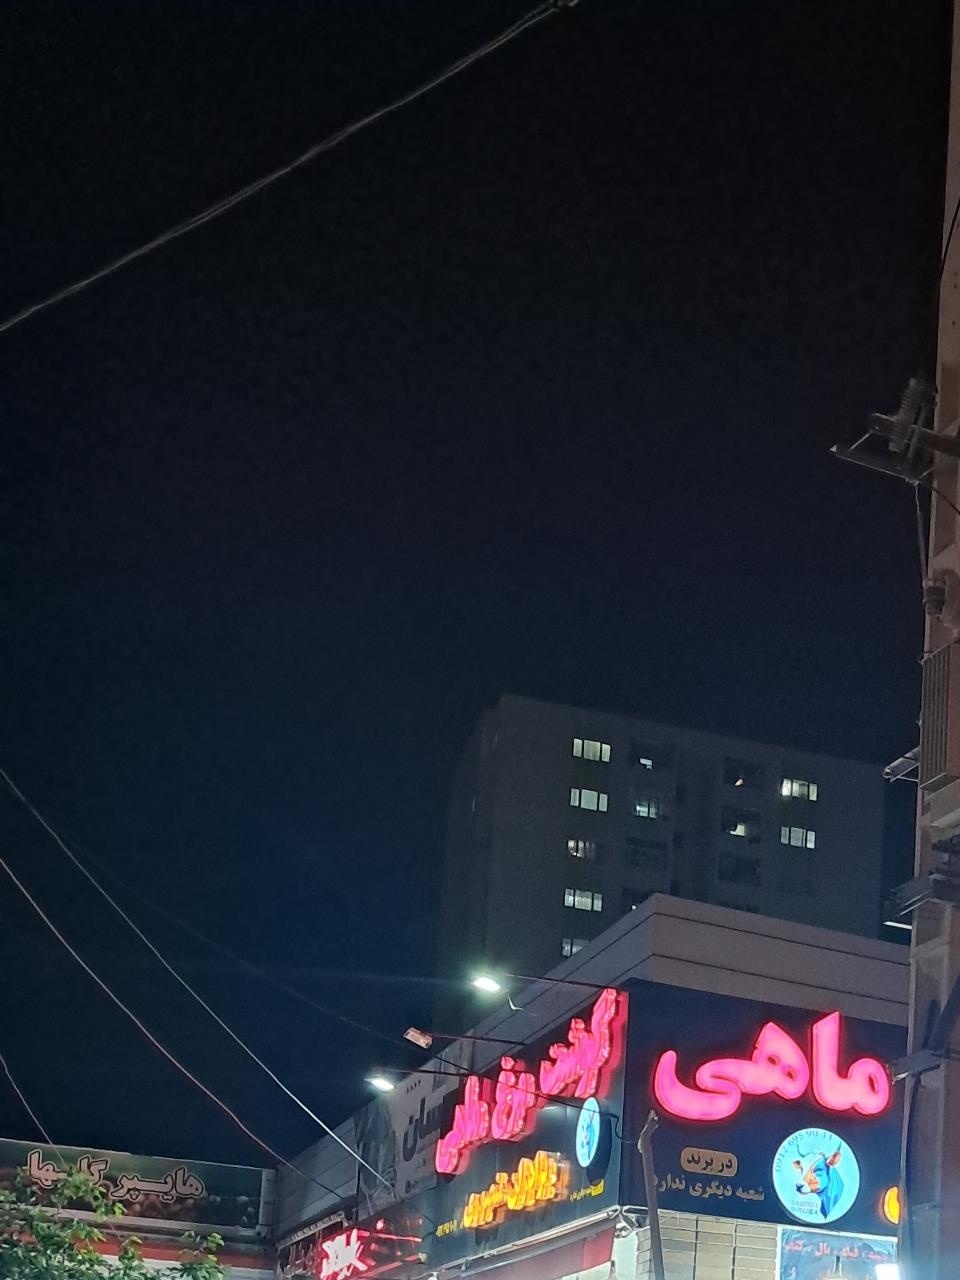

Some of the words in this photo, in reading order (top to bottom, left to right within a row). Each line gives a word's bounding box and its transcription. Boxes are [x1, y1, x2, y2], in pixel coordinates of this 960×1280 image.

[654, 1011, 891, 1121] ماهی
[110, 1166, 204, 1202] هایپر
[655, 1173, 686, 1192] ندار
[689, 1180, 733, 1199] دیگری
